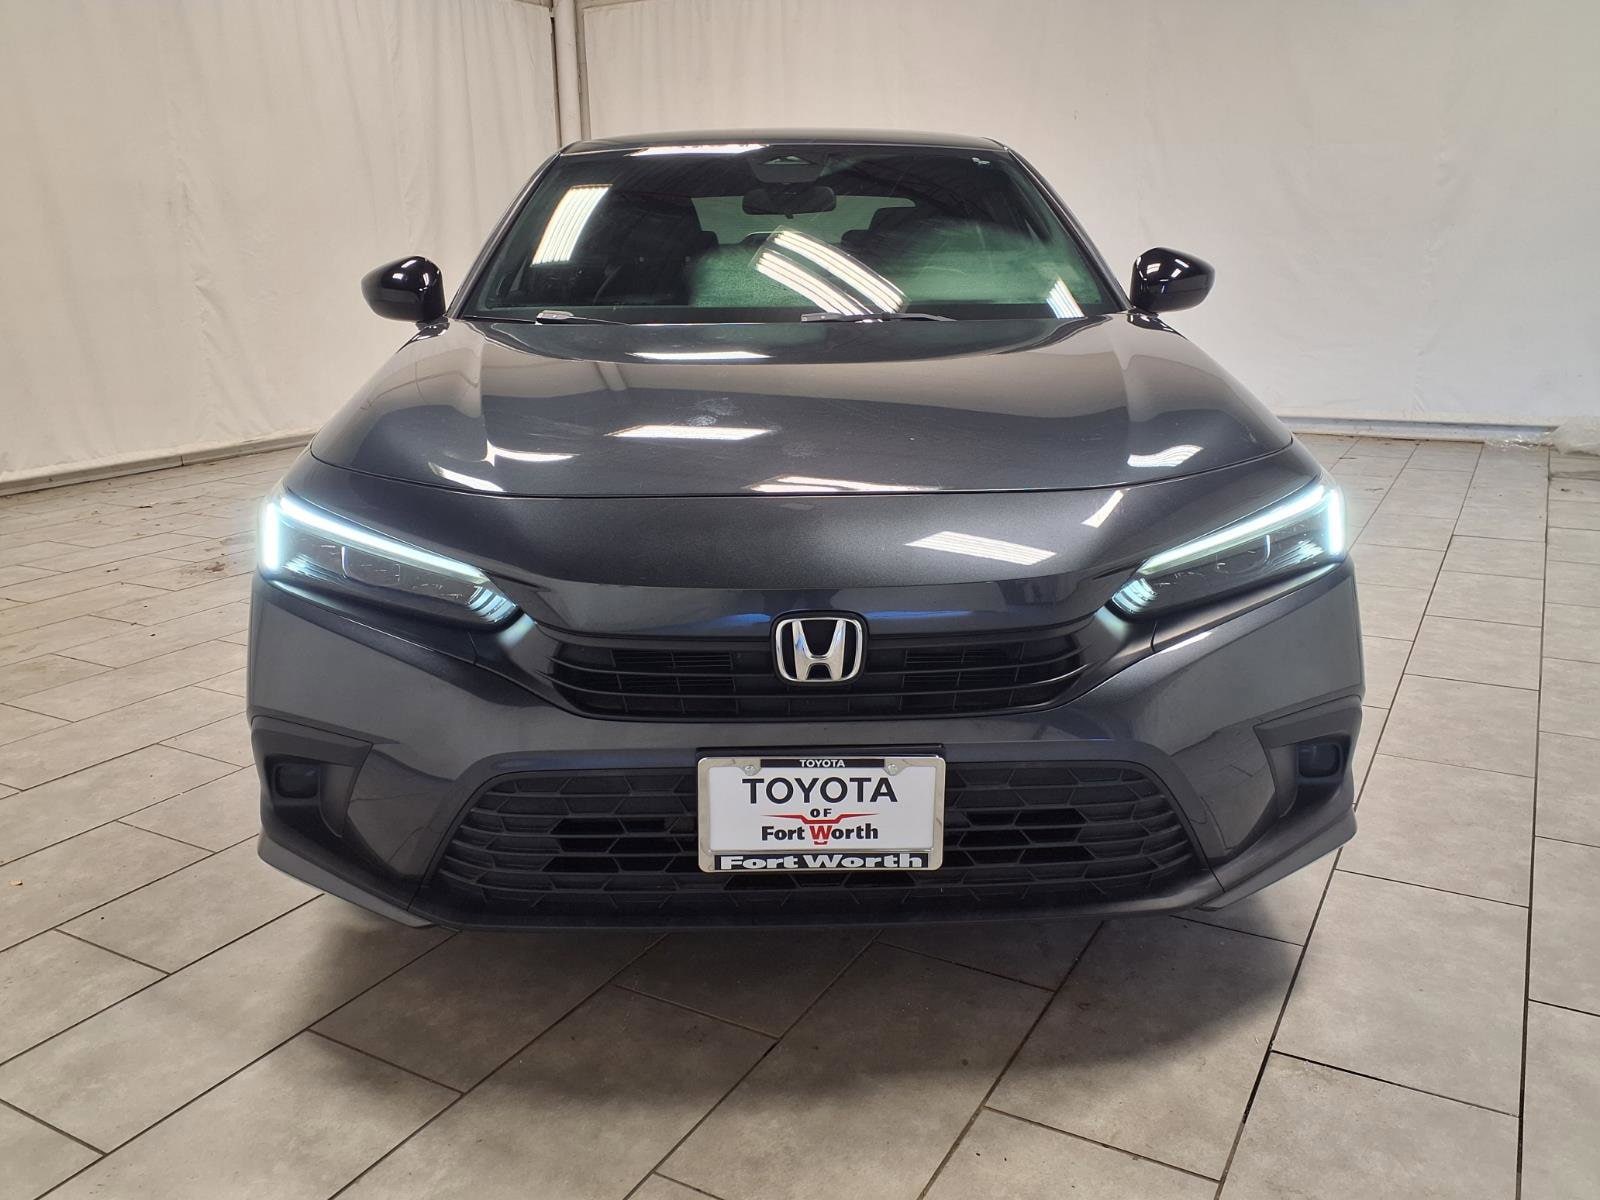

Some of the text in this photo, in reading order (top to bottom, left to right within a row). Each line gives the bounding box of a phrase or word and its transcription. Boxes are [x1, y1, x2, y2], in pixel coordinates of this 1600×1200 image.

[799, 759, 846, 768] TOYOTA
[742, 777, 898, 804] TOYOTA
[810, 808, 832, 818] OF
[761, 823, 879, 841] Fort Worth
[720, 853, 922, 870] Fort Worth
